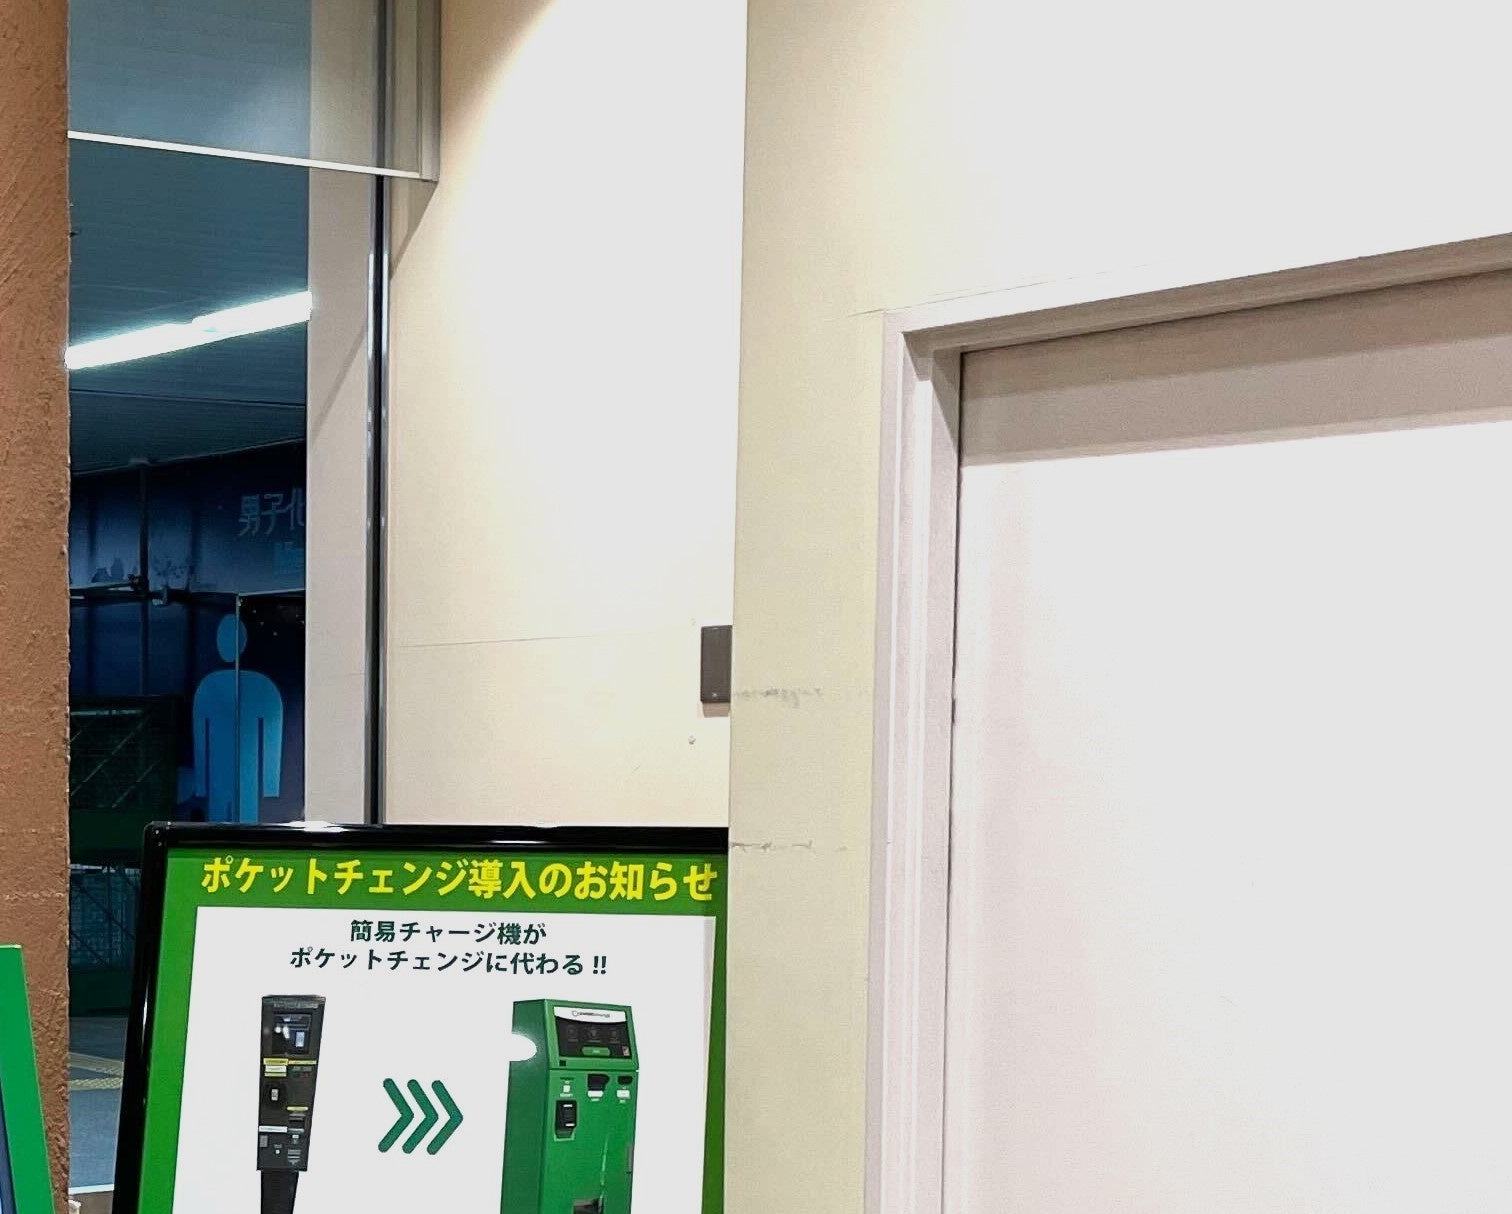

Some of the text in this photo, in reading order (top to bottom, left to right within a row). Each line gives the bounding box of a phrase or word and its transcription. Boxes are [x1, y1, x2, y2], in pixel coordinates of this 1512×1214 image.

[201, 855, 718, 902] ポケットチェンジ導入のお知らせ
[349, 919, 547, 946] 簡易チャージ機が
[290, 944, 585, 976] ポケットチェンジに代わる
